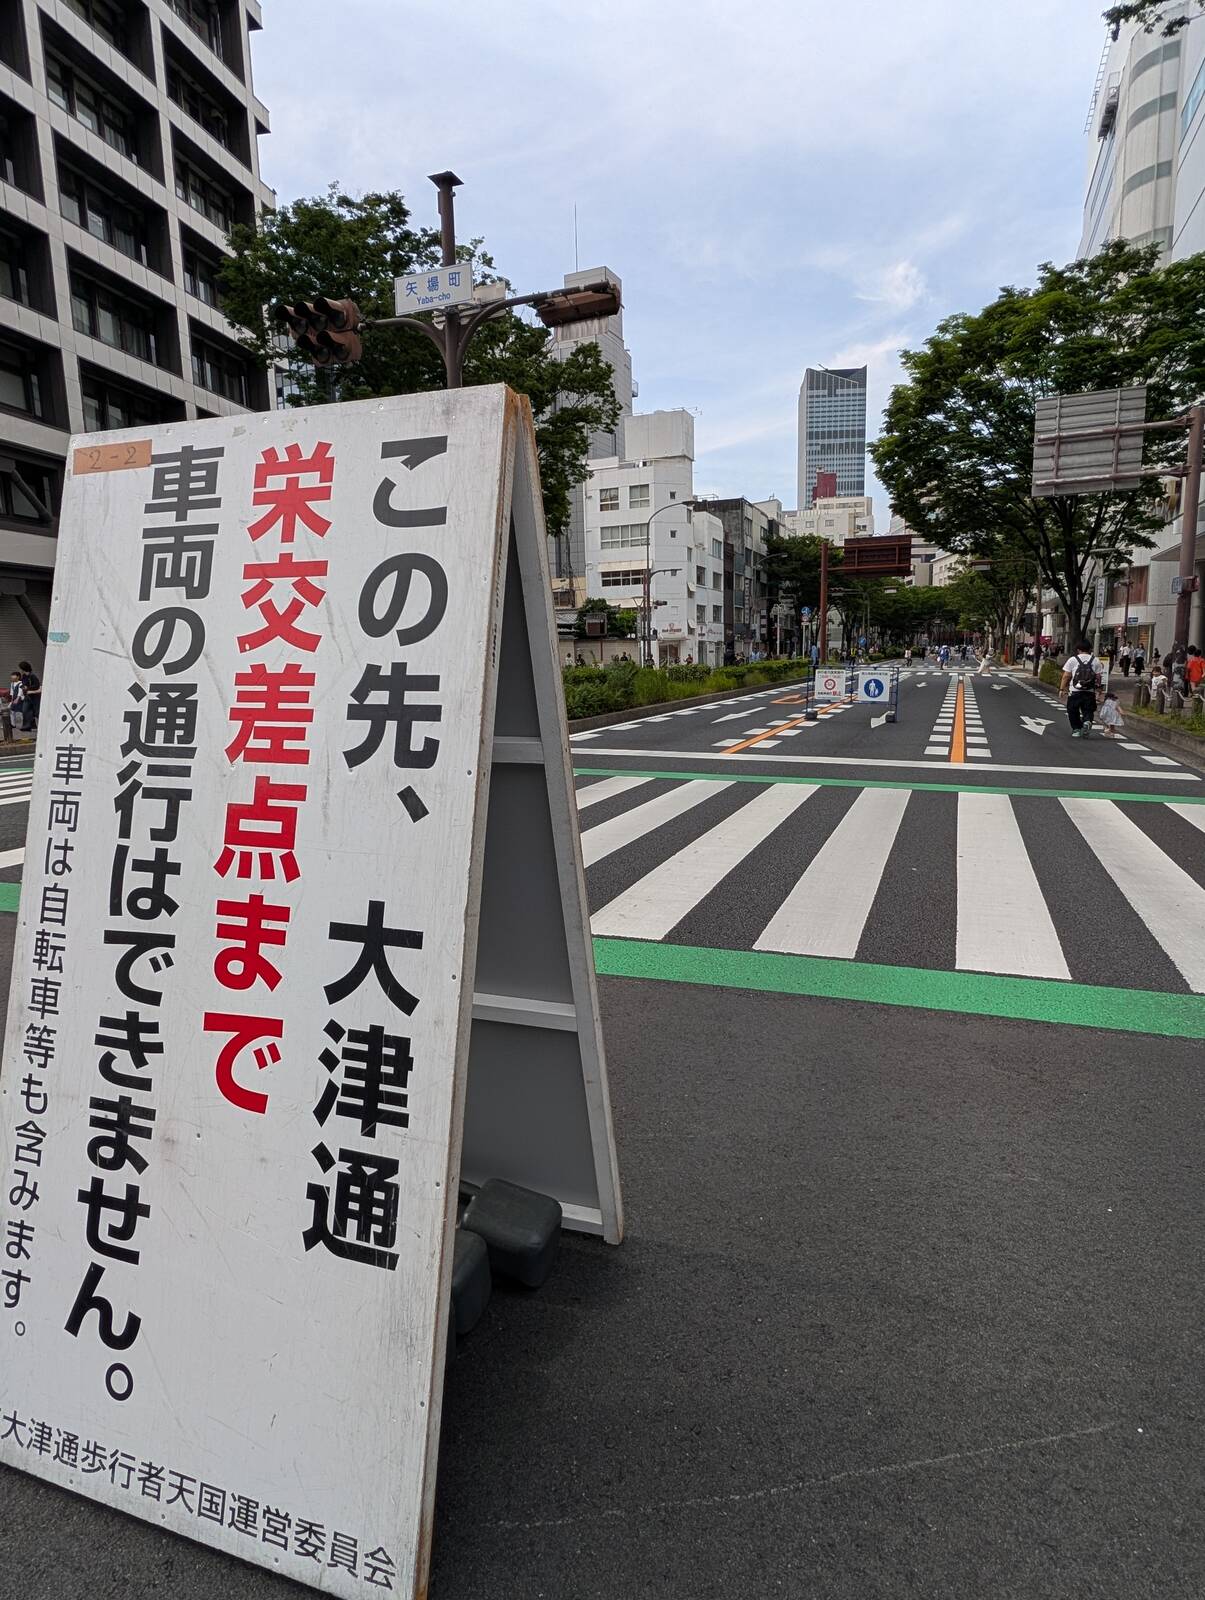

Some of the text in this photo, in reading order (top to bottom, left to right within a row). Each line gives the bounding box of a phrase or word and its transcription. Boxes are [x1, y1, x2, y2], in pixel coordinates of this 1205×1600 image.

[406, 272, 461, 297] 矢場町
[417, 293, 451, 305] Yaba-cho
[89, 445, 137, 470] 2-2
[203, 440, 336, 1115] 栄交差点まで
[302, 435, 448, 1271] この先、 大津通
[63, 445, 225, 1401] 車両の通行はできません。
[1, 1410, 397, 1592] 大津通歩行者天国運営委員会
